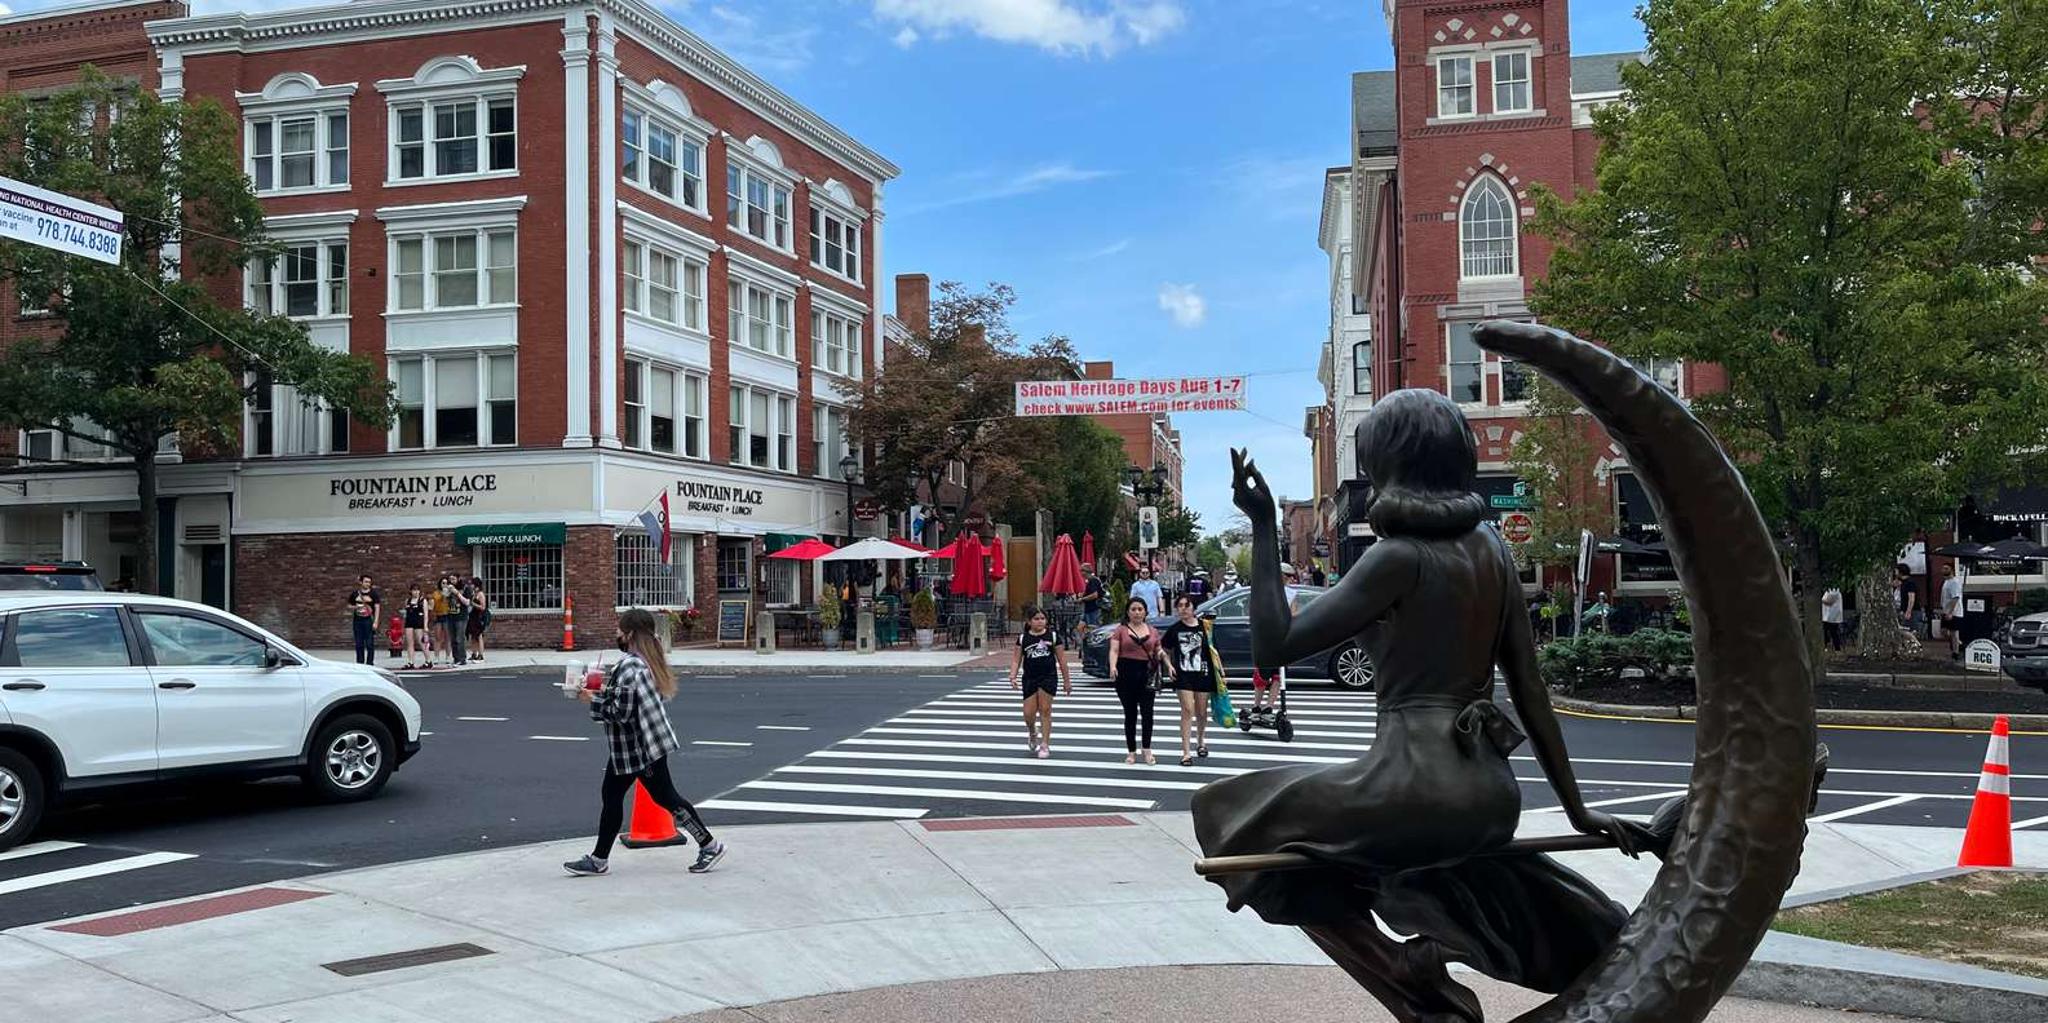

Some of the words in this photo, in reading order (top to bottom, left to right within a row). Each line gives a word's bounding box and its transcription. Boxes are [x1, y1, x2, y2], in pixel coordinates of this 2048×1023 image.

[3, 208, 34, 224] vaccine
[11, 194, 45, 211] NATIONAL
[45, 203, 72, 219] HEALTH
[72, 210, 98, 226] CENTER
[37, 217, 117, 255] 978.744.8388
[1020, 383, 1066, 398] Salem
[1071, 381, 1135, 397] Heritage
[1140, 380, 1176, 395] Days
[1180, 378, 1208, 394] Aug
[1214, 379, 1240, 393] 1-7
[1024, 402, 1062, 415] check
[1065, 400, 1167, 414] www.SALEM.com
[1171, 399, 1190, 412] for
[1193, 398, 1238, 411] events
[330, 476, 429, 496] FOUNTAIN
[435, 474, 497, 493] PLACE
[677, 481, 731, 501] FOUNTAIN
[733, 487, 763, 505] PLACE
[349, 497, 416, 510] BREAKFAST
[433, 495, 474, 507] LUNCH
[688, 500, 724, 513] BREAKFAST
[732, 504, 753, 516] LUNCH
[467, 535, 507, 544] BREAKFAST
[507, 535, 514, 543] &
[515, 534, 541, 543] LUNCH
[1974, 652, 1992, 664] RCG
